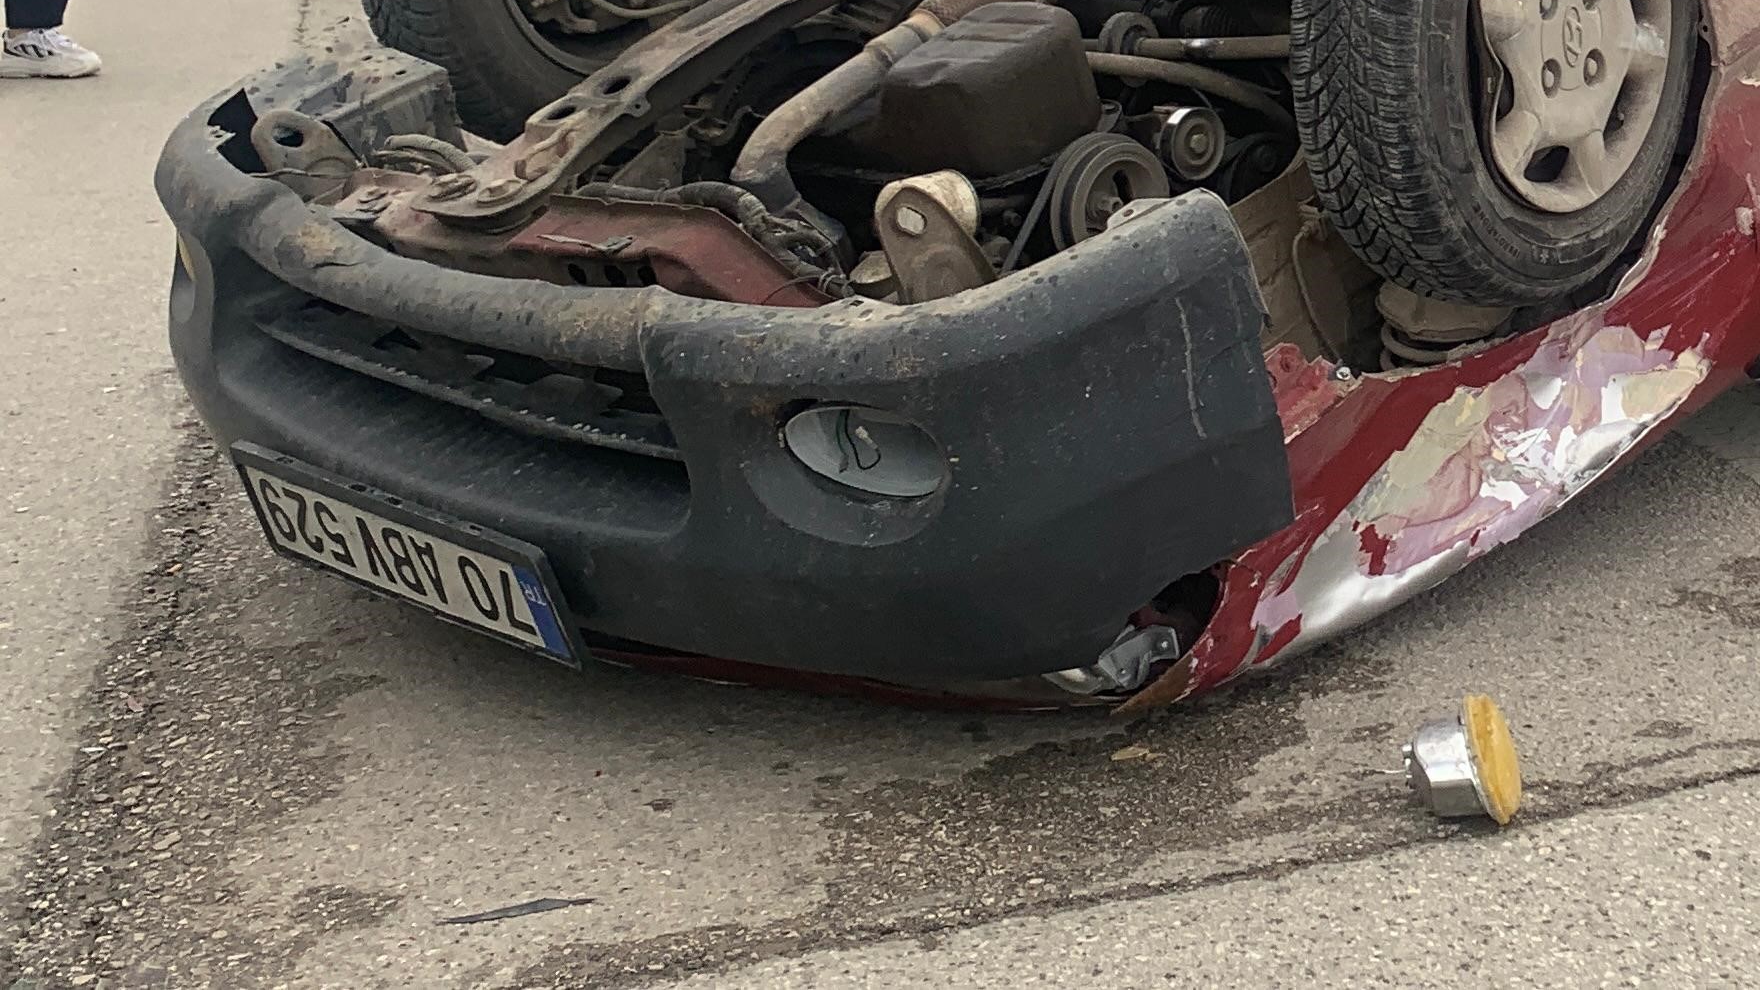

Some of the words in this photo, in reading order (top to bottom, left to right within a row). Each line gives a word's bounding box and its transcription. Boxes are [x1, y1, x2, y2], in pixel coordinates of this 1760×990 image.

[259, 479, 356, 567] 529
[356, 517, 448, 604] ABV
[458, 556, 537, 636] 70
[520, 581, 547, 606] TR
